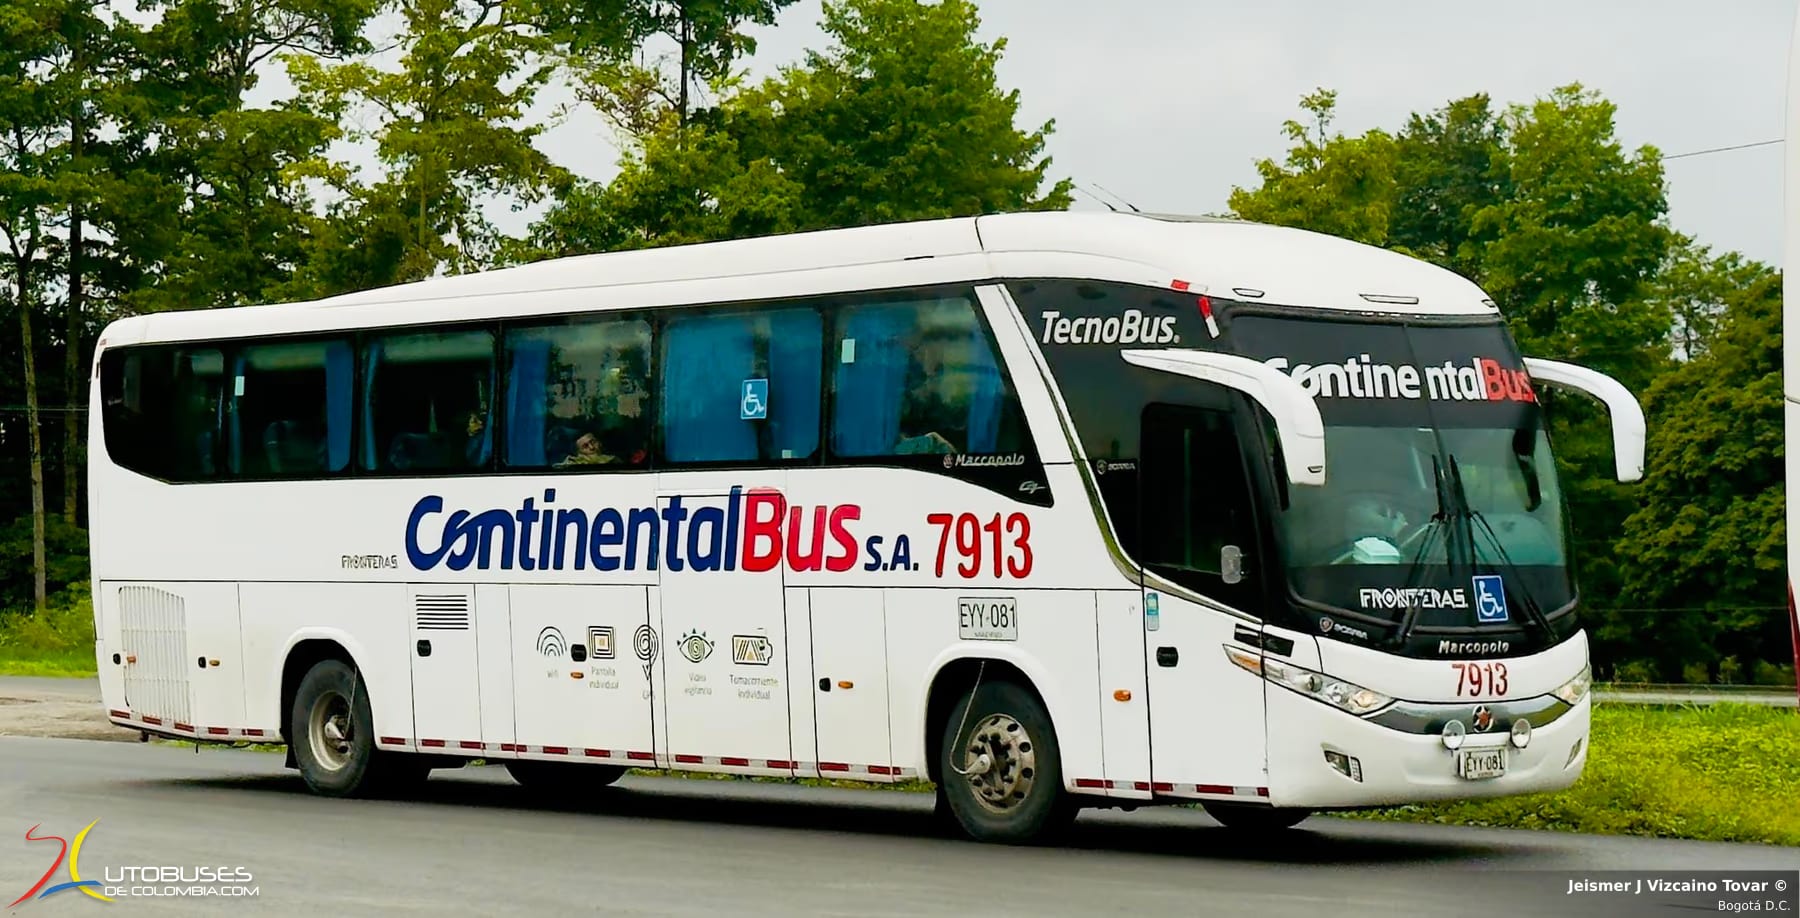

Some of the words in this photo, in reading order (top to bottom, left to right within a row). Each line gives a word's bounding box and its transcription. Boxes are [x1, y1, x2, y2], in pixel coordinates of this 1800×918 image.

[404, 485, 861, 573] ContinentalBus
[864, 534, 919, 572] S.A.
[926, 512, 1034, 579] 7913
[1438, 639, 1510, 655] Marcopolo
[1451, 662, 1509, 697] 7913
